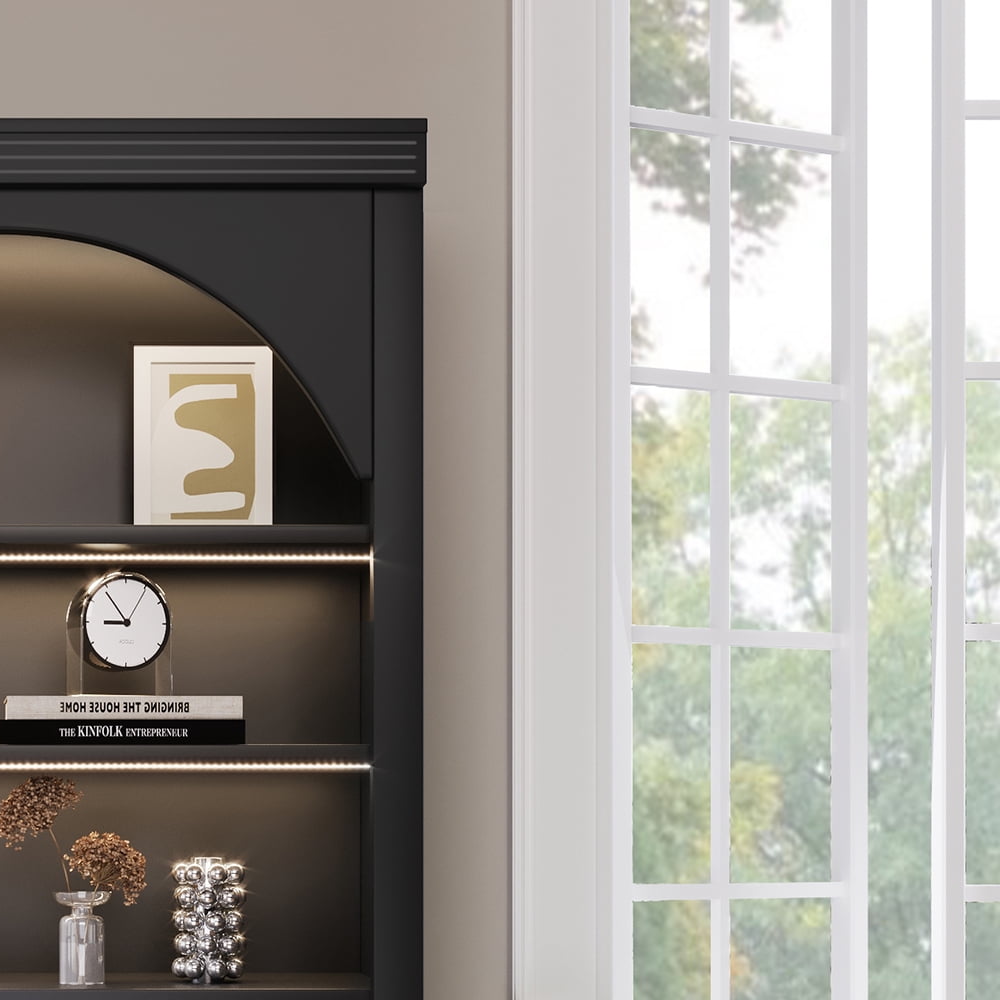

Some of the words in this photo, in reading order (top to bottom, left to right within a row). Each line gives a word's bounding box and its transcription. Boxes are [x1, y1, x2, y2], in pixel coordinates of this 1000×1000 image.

[59, 728, 77, 737] THE
[77, 725, 123, 738] KINFOLK
[125, 728, 189, 738] ENTREPRENEUR
